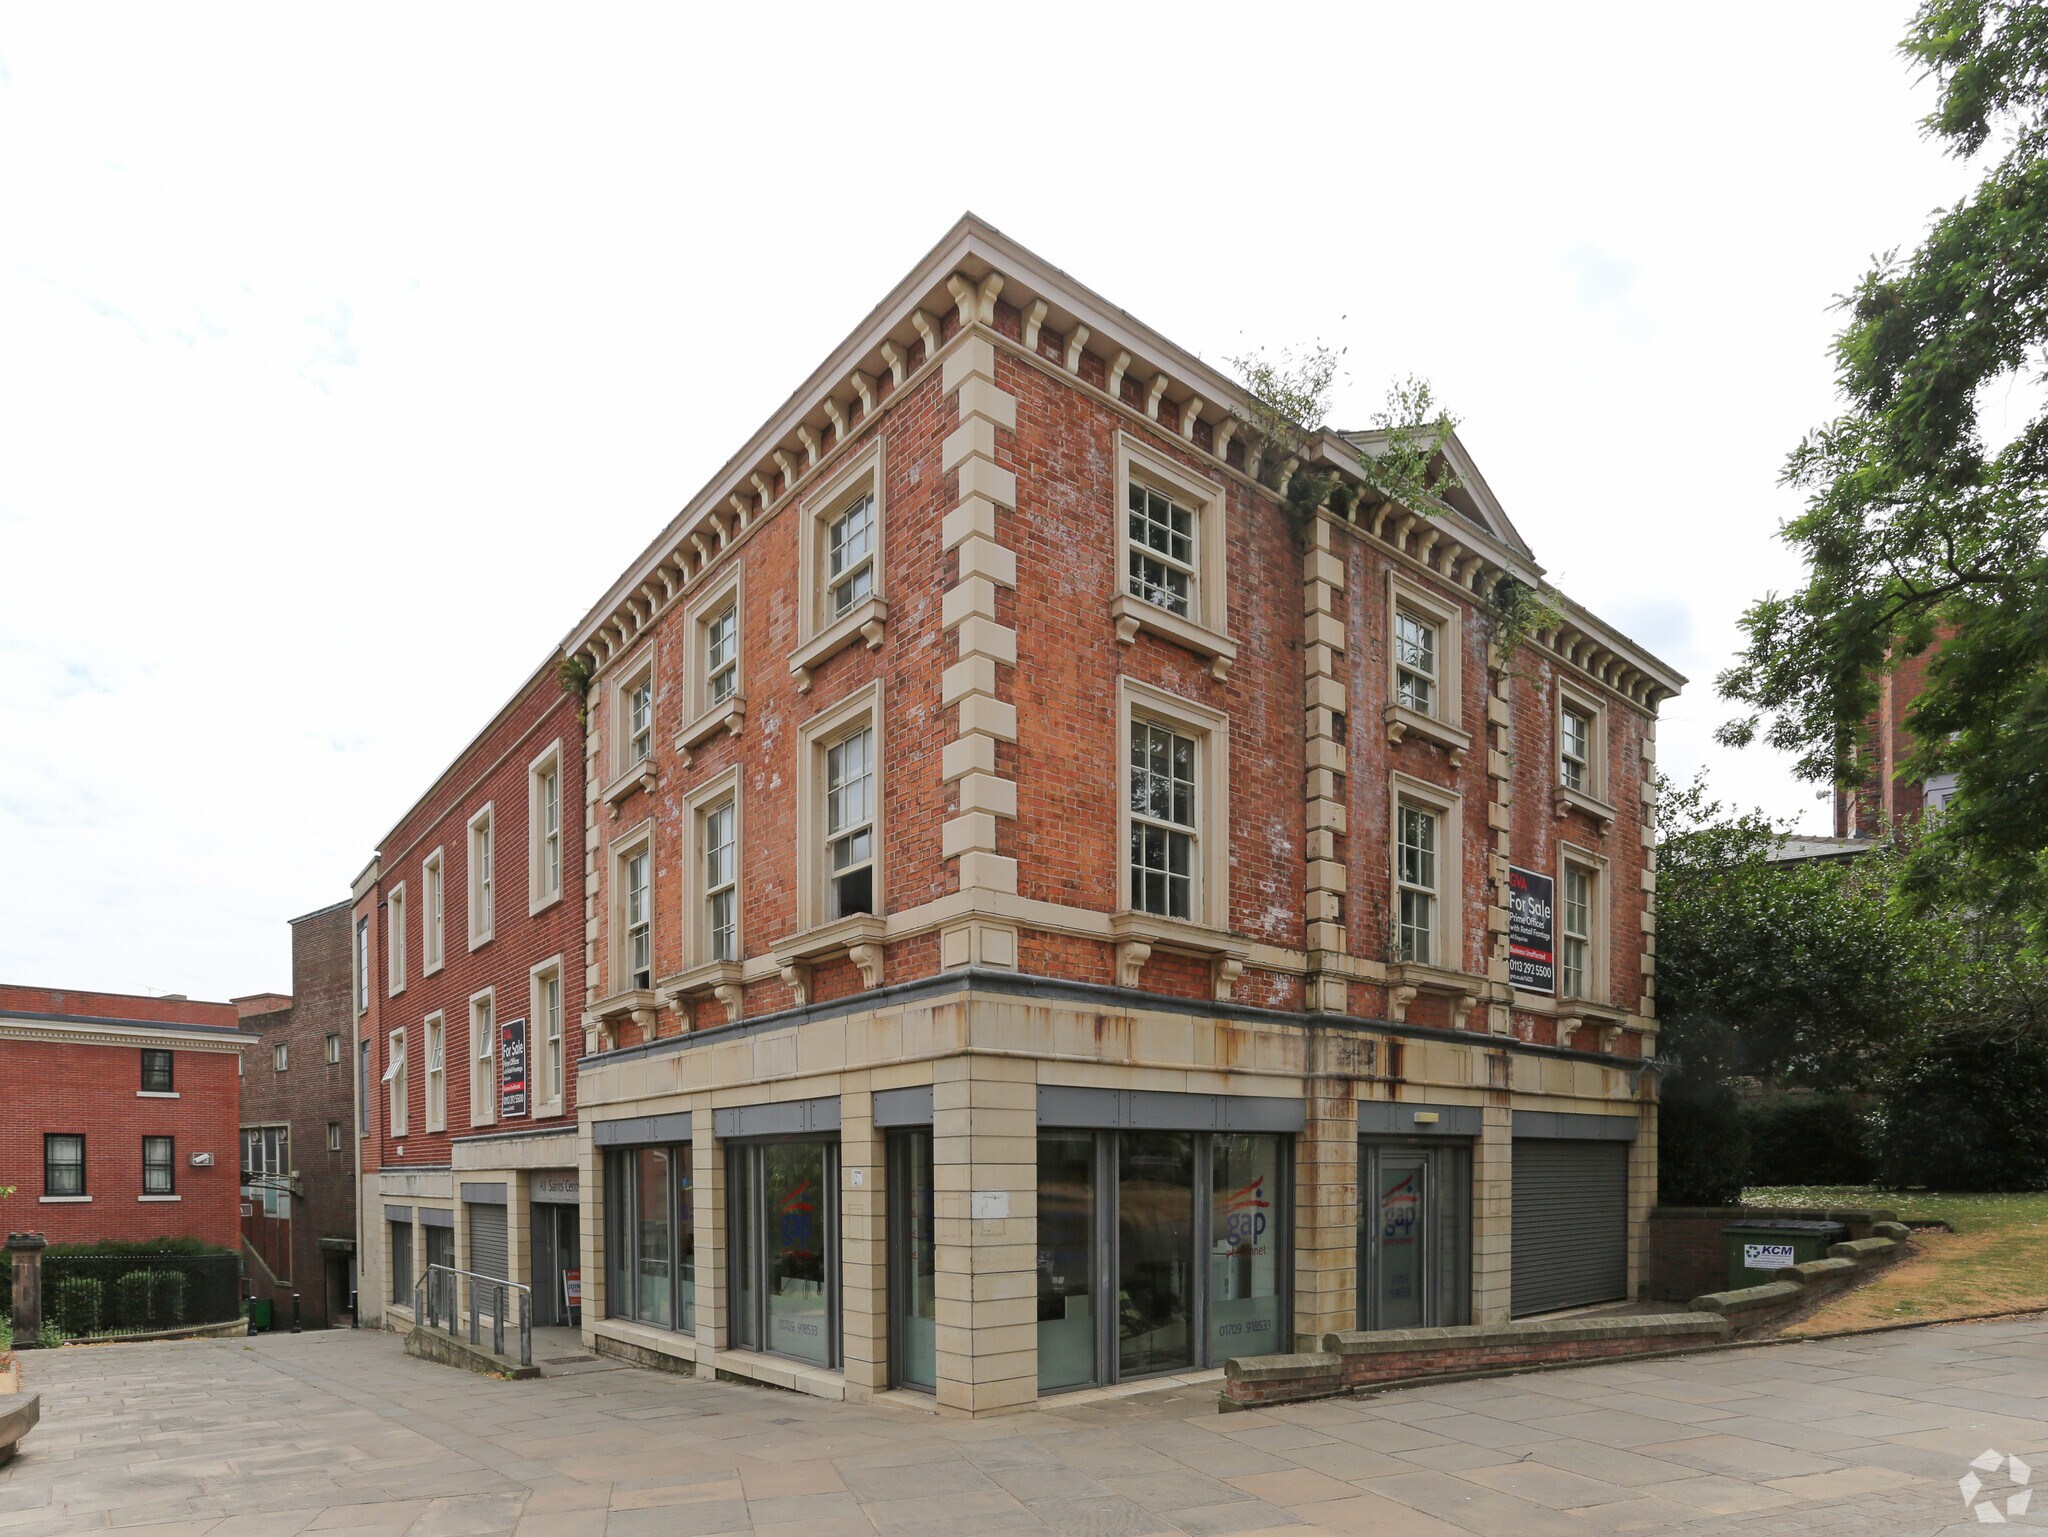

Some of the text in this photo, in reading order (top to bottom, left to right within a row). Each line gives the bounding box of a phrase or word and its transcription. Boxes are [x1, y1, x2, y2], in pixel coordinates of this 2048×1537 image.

[1510, 873, 1527, 891] GVA
[1510, 891, 1551, 918] For Sale
[1510, 912, 1545, 929] Prime Offices
[1510, 923, 1551, 941] with Retail Frontage
[1510, 959, 1552, 978] 0113 292 5500
[538, 1180, 547, 1192] All
[1226, 1212, 1267, 1247] gap
[1385, 1206, 1416, 1236] gap
[1761, 1245, 1793, 1256] KCM
[1219, 1319, 1272, 1337] 01709 918533
